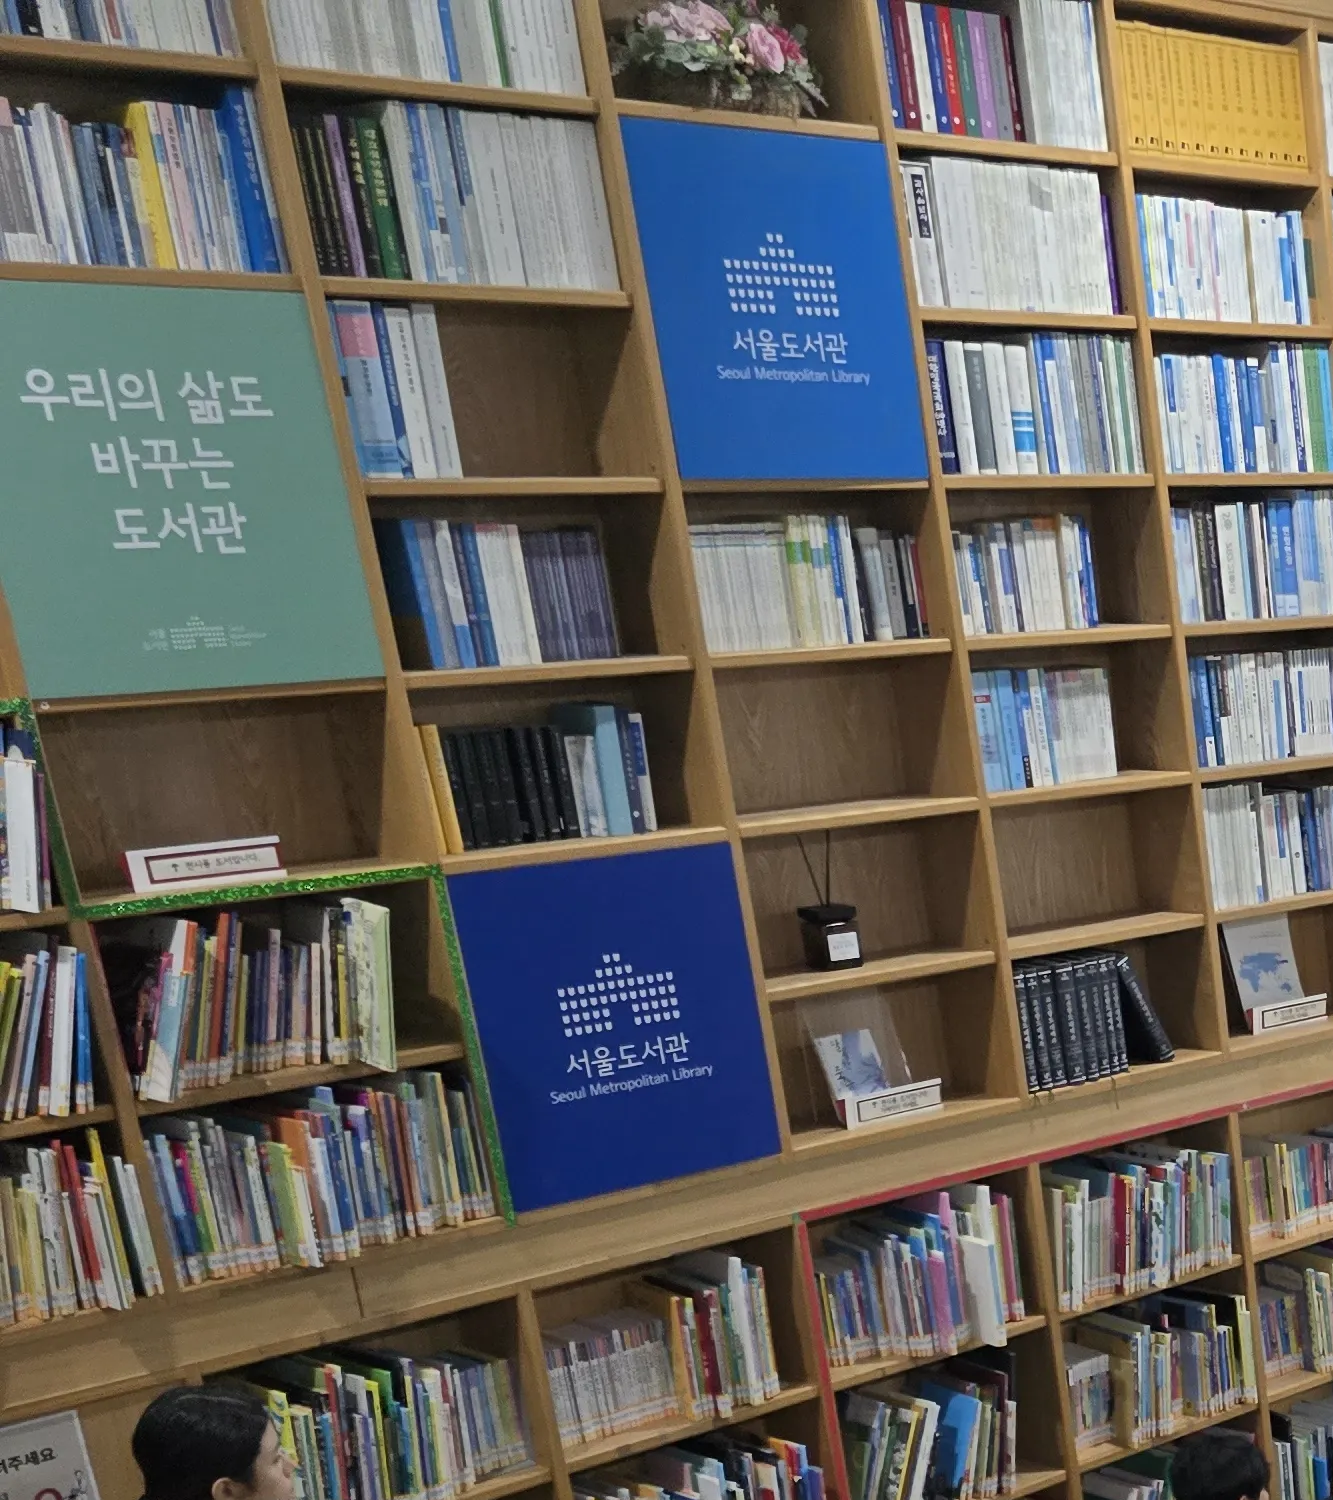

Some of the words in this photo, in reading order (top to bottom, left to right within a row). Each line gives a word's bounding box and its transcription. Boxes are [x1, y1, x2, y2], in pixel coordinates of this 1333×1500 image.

[733, 328, 848, 364] 서울도서관
[20, 368, 165, 422] 우리의
[177, 370, 274, 425] 삶도
[717, 365, 751, 380] Seoul
[754, 366, 829, 383] Metropolitan
[832, 369, 871, 386] Library
[90, 436, 234, 489] 바꾸는
[113, 502, 247, 554] 도서관
[566, 1032, 690, 1079] 서울도서관
[550, 1086, 587, 1105] Seoul
[589, 1071, 669, 1097] Metropolitan
[672, 1062, 713, 1081] Library
